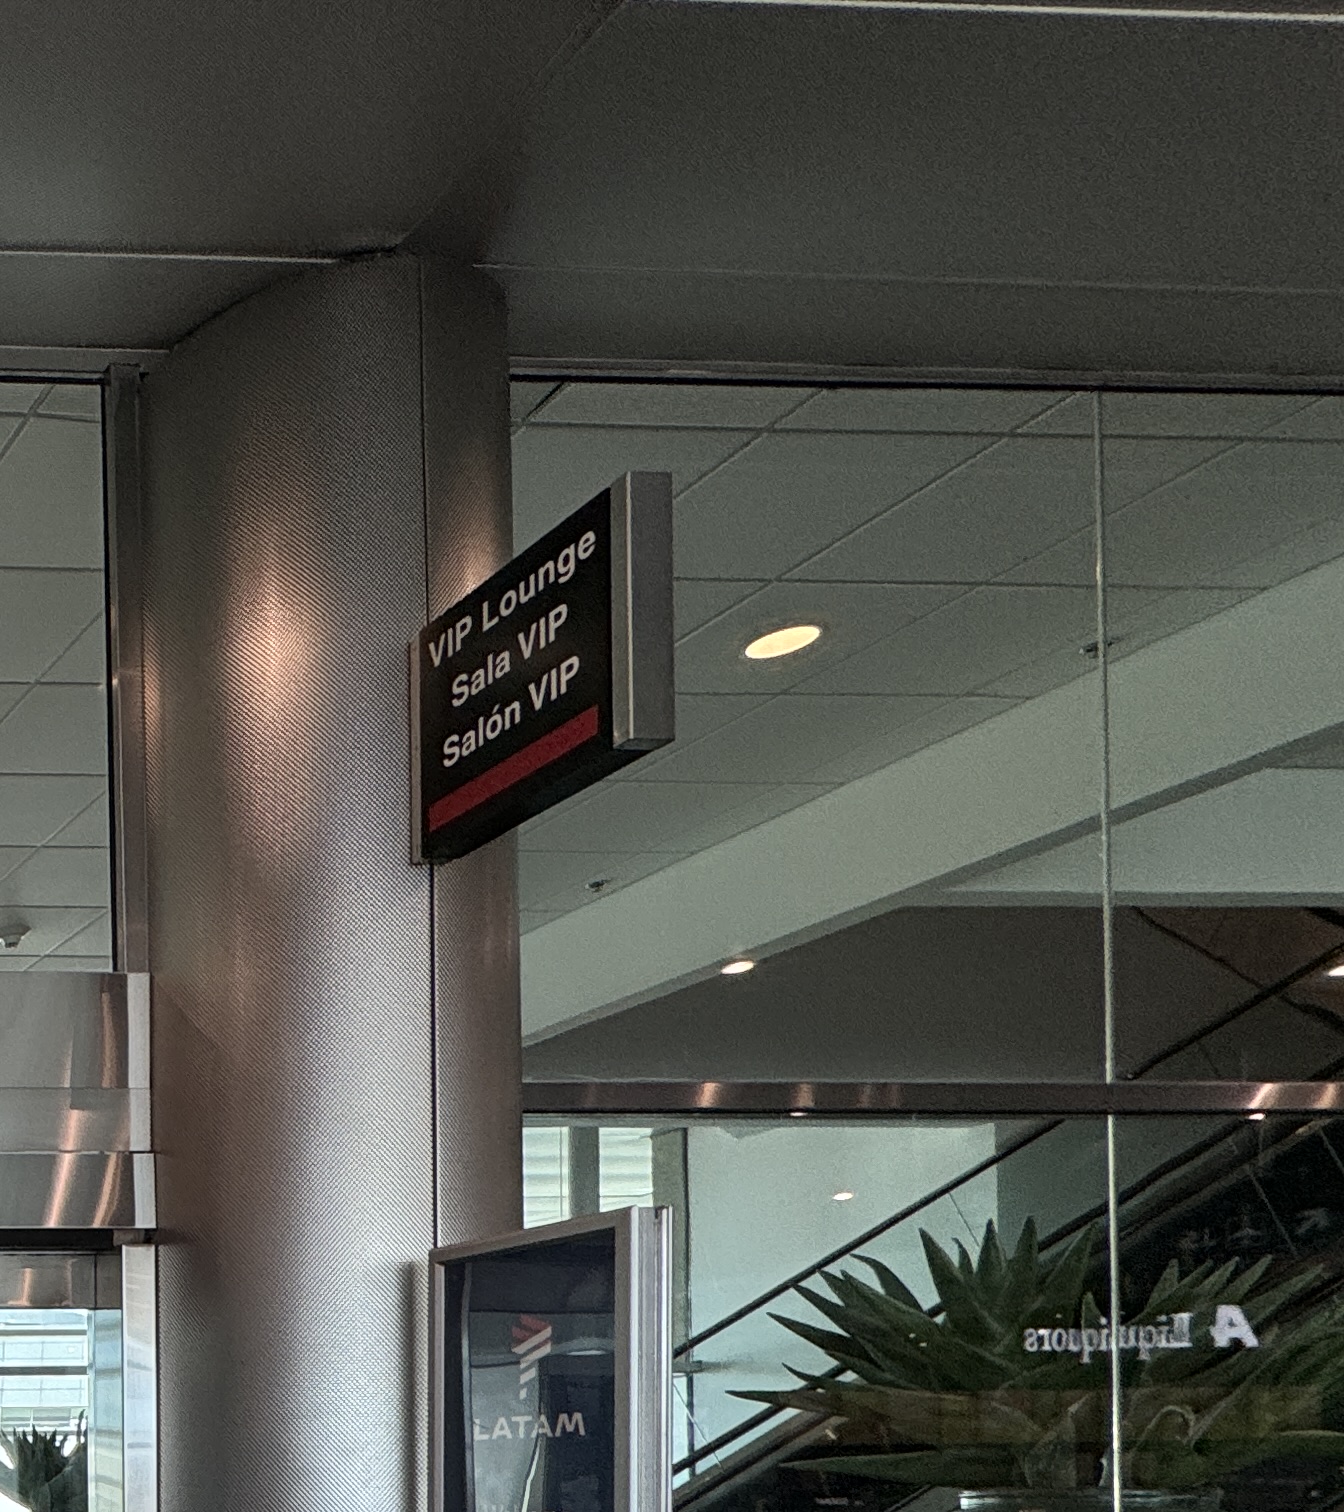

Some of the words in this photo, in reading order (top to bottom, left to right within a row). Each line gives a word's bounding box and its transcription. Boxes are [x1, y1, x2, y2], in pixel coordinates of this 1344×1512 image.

[427, 614, 473, 668] VIP
[482, 529, 597, 632] Lounge
[450, 649, 511, 708] Sala
[517, 603, 568, 660] VIP
[442, 700, 521, 768] Salón
[528, 655, 580, 711] VIP
[473, 1411, 586, 1441] LATAM
